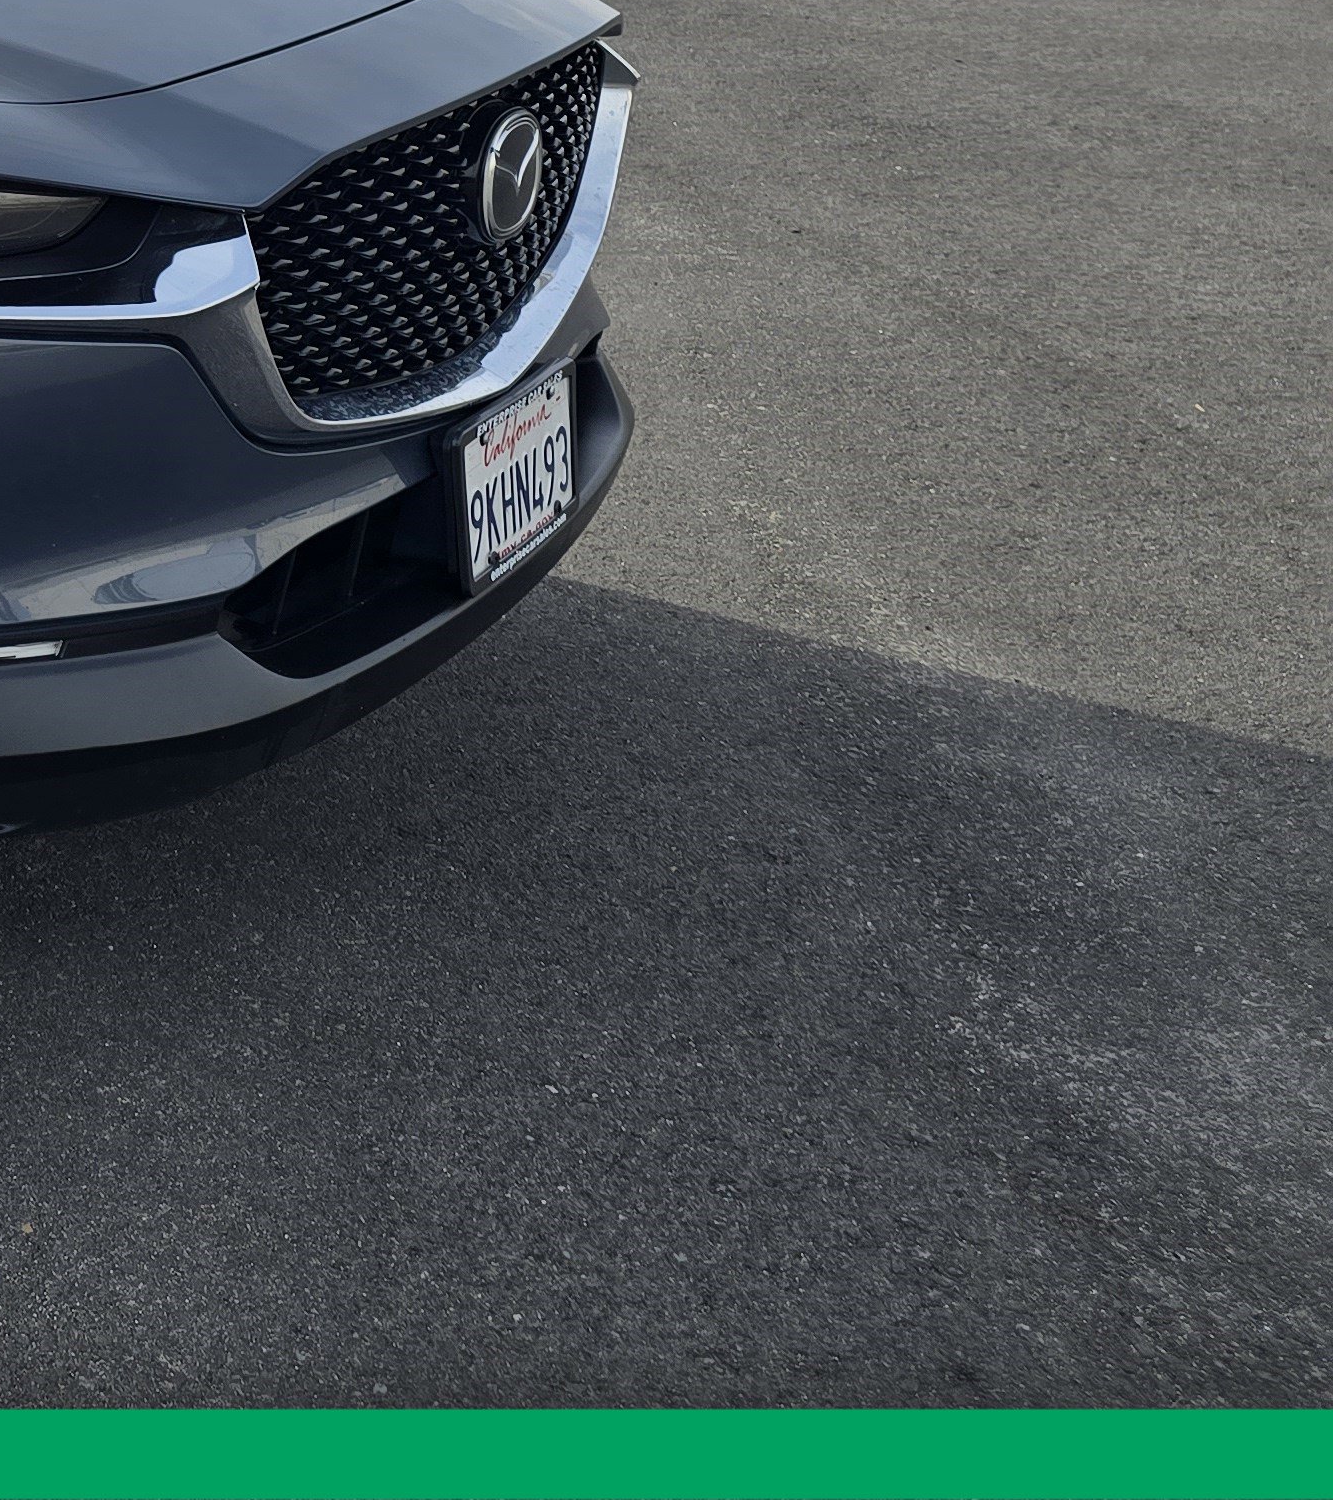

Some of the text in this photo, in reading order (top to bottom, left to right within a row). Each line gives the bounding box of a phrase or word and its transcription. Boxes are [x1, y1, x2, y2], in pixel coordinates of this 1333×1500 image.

[476, 396, 527, 439] ENTERPRISE
[483, 403, 551, 467] California
[470, 424, 569, 564] 9KHN493
